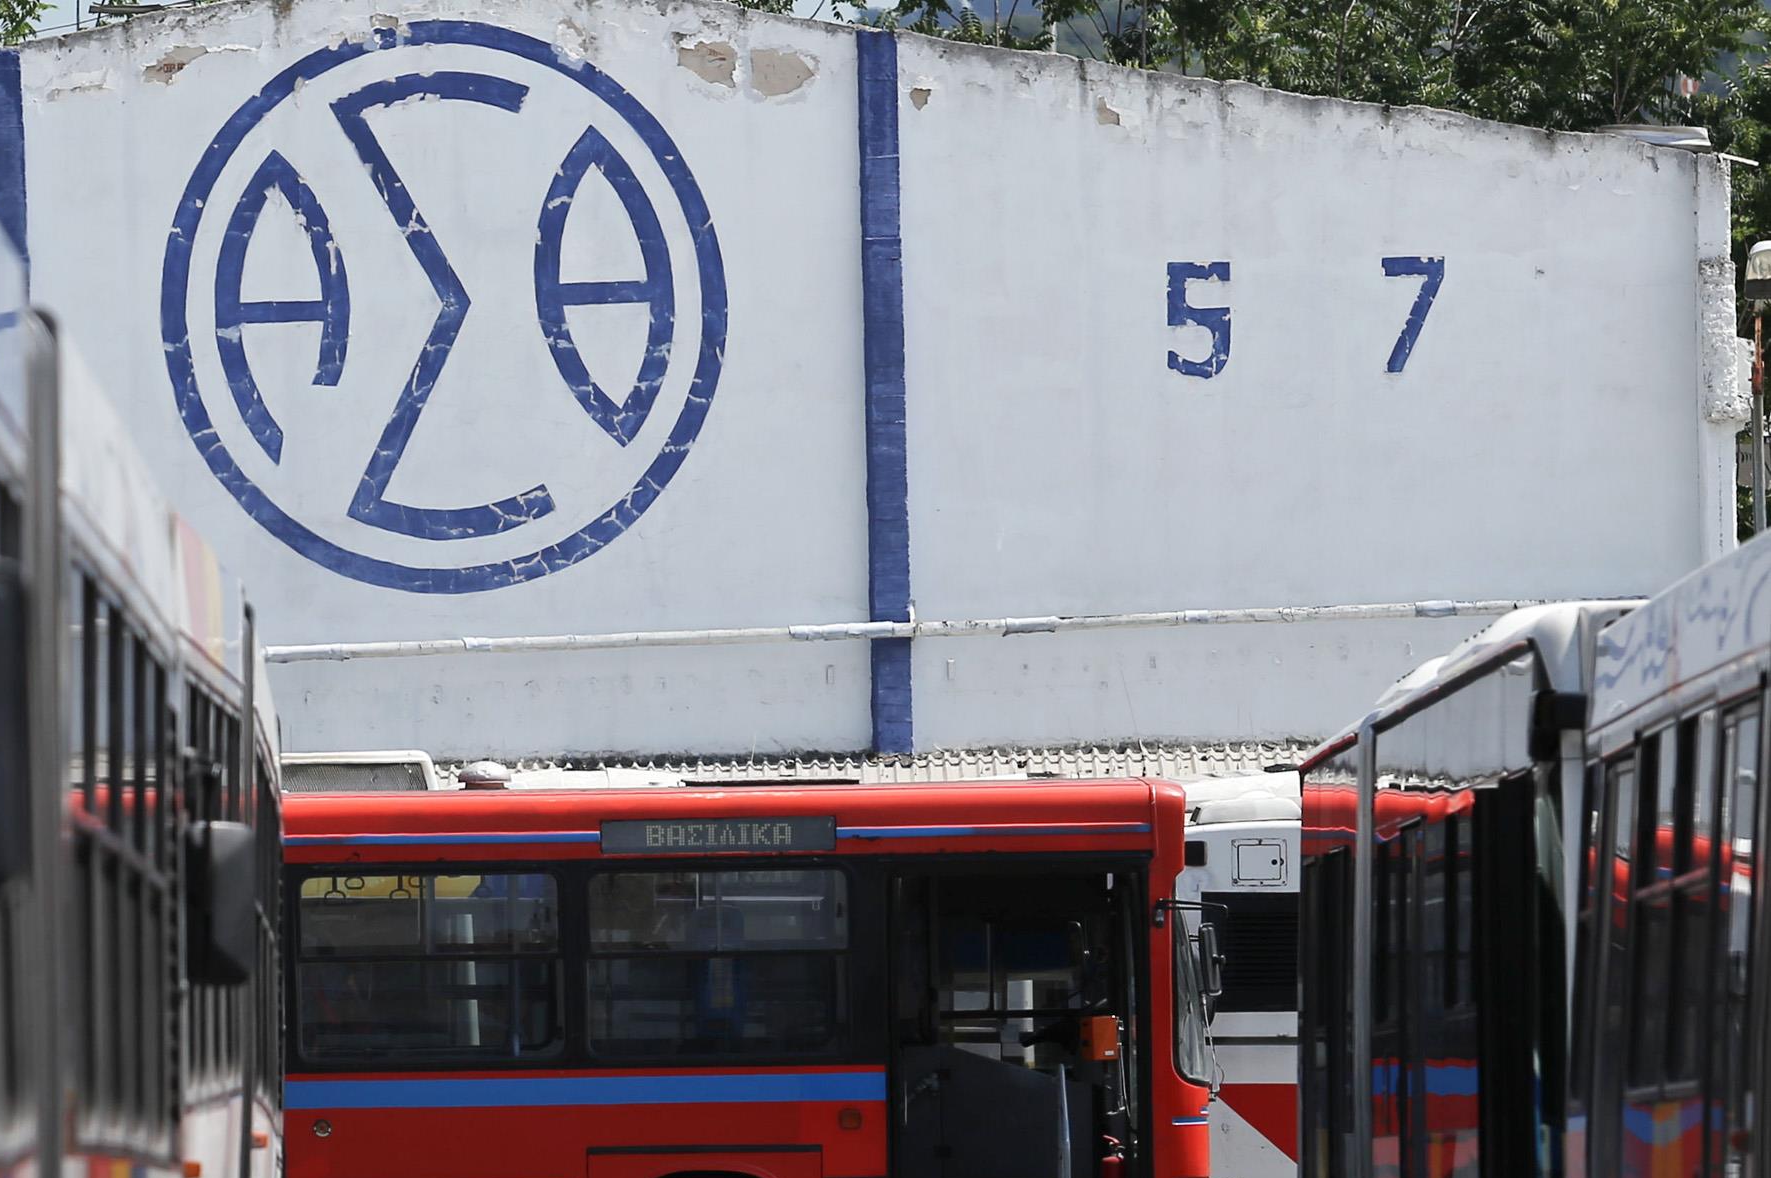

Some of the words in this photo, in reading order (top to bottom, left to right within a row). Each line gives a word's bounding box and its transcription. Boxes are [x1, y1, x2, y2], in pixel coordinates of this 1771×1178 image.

[1166, 261, 1231, 380] 5
[1380, 256, 1445, 374] 7
[645, 823, 792, 847] ΒΑΣΙΛΙΚΑ
